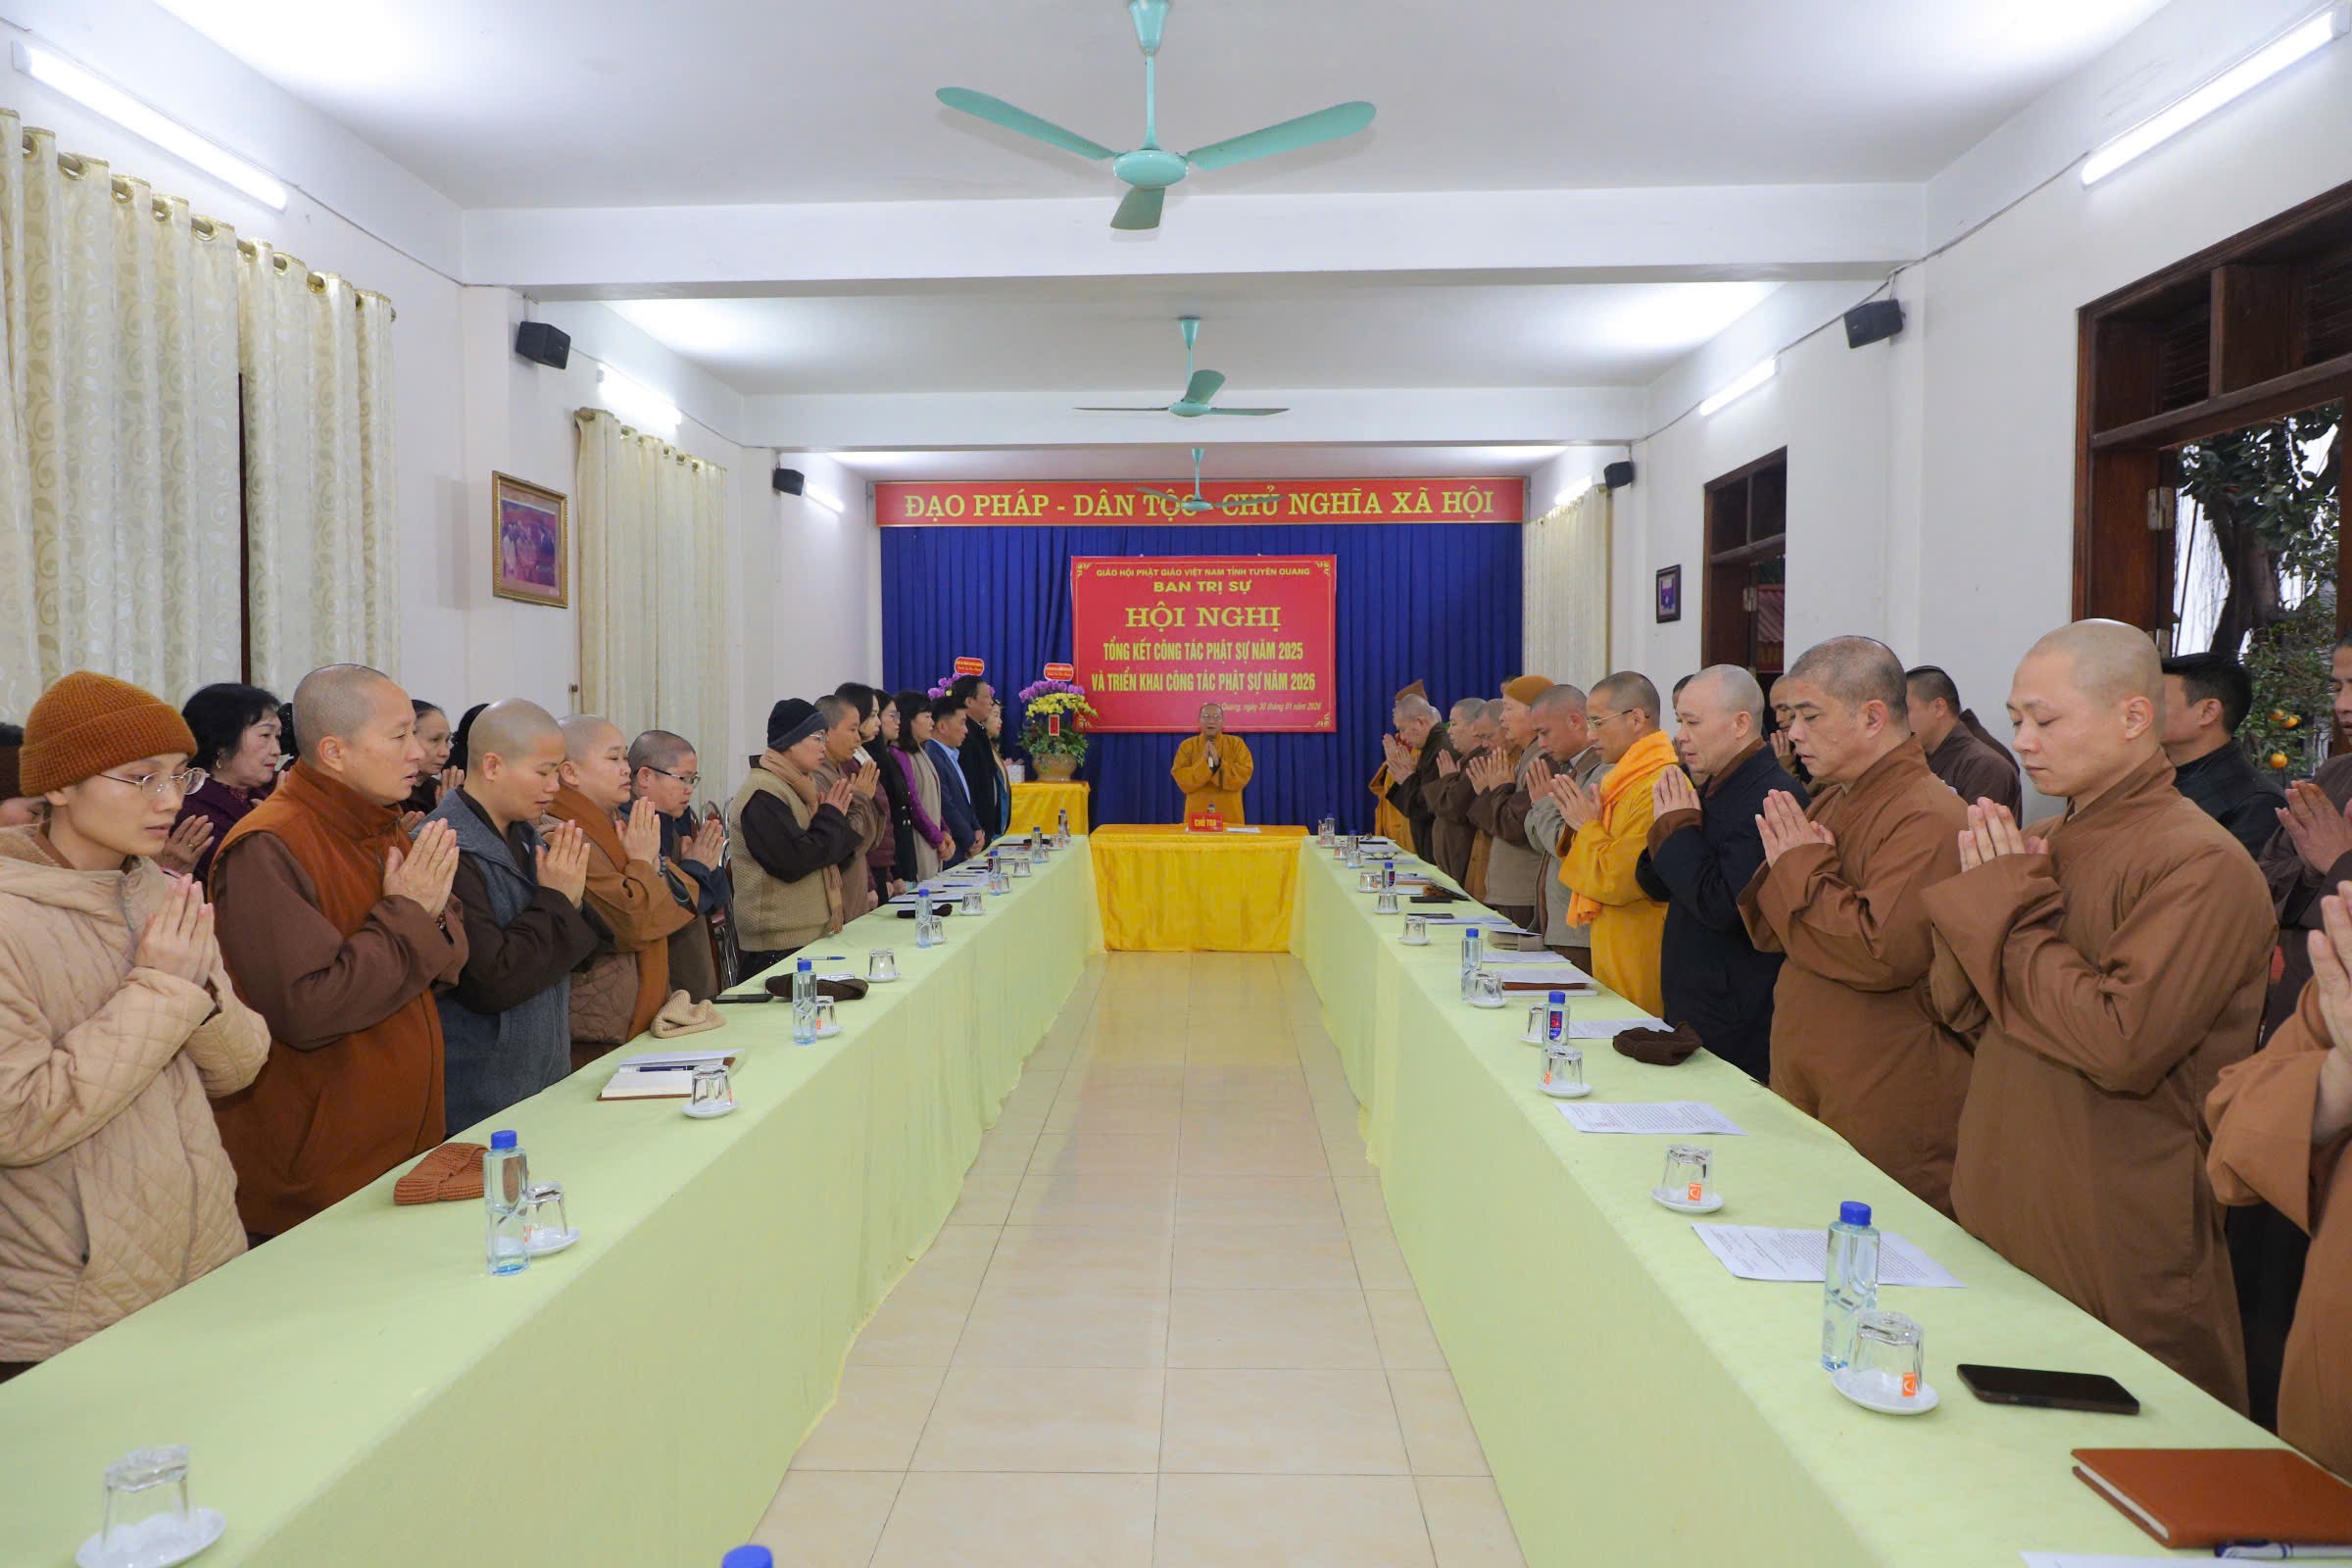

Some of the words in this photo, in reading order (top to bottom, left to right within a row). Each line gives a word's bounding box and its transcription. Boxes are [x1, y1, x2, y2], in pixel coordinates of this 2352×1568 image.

[904, 494, 965, 522] ĐẠO
[972, 488, 1050, 517] PHÁP
[1073, 488, 1136, 516] DÂN
[1221, 485, 1280, 515] CHỦ
[1288, 487, 1384, 515] NGHĨA
[1391, 487, 1435, 514] XÃ
[1441, 486, 1495, 519] HỘI
[1096, 567, 1118, 577] GIÁO
[1119, 568, 1135, 578] HỘI
[1136, 567, 1158, 578] PHẬT
[1160, 567, 1182, 576] GIÁO
[1184, 566, 1203, 577] VIỆT
[1249, 567, 1277, 576] TUYÊN
[1278, 567, 1310, 576] QUANG
[1153, 581, 1192, 593] BAN
[1197, 581, 1223, 595] TRỊ
[1228, 580, 1252, 594] SỰ
[1125, 601, 1186, 632] HỘI
[1196, 607, 1282, 632] NGHỊ
[1102, 635, 1130, 661] TỔNG
[1132, 637, 1152, 661] KẾT
[1153, 639, 1182, 661] CÔNG
[1184, 639, 1204, 661] TÁC
[1206, 639, 1233, 664] PHẬT
[1235, 641, 1250, 664] SỰ
[1251, 639, 1276, 661] NĂM
[1278, 642, 1303, 661] 2025
[1091, 670, 1105, 692] VÀ
[1107, 666, 1137, 691] TRIỂN
[1139, 673, 1163, 691] KHAI
[1165, 670, 1195, 691] CÔNG
[1197, 669, 1216, 691] TÁC
[1218, 669, 1246, 695] PHẬT
[1247, 671, 1262, 695] SỰ
[1263, 669, 1288, 691] NĂM
[1290, 672, 1315, 691] 2026
